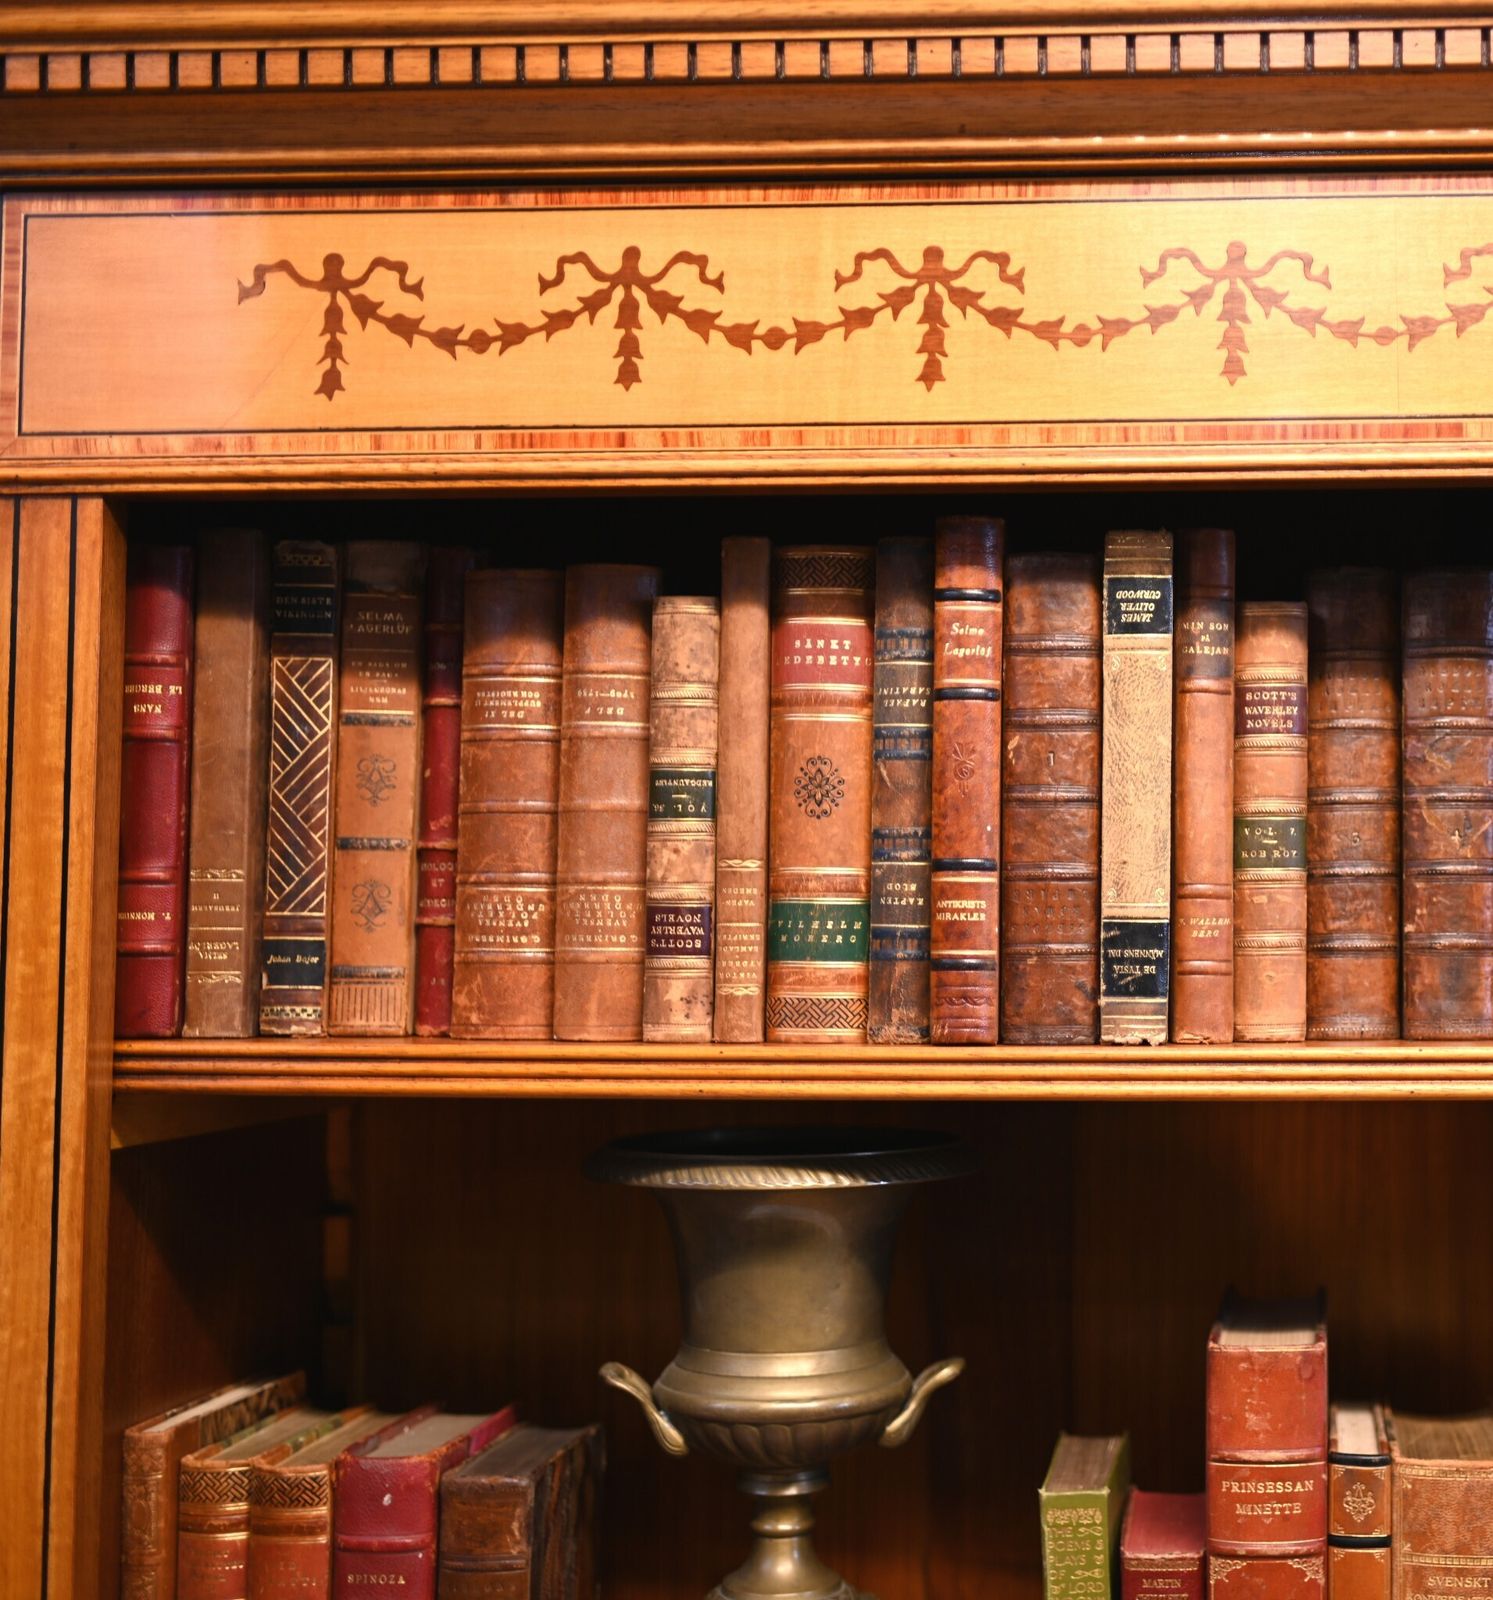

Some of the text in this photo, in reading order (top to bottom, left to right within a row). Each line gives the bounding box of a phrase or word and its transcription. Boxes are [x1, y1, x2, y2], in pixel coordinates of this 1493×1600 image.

[1115, 590, 1161, 599] CURWOOD
[1120, 602, 1155, 611] OLIVER
[357, 610, 404, 622] SELMA
[1121, 613, 1153, 623] JAMES
[950, 622, 985, 636] Selma
[1183, 621, 1229, 630] MIN SON
[1183, 646, 1229, 656] GALEJAN
[168, 684, 183, 694] LE
[878, 687, 931, 696] SABATINI
[1245, 691, 1297, 701] SCOTT'S
[884, 699, 927, 707] RAFAEL
[501, 710, 525, 718] DEL
[596, 707, 625, 715] DEL
[1244, 705, 1299, 715] WAVERLEY
[1246, 719, 1293, 728] NOVELS
[655, 778, 713, 787] REDGAUNTLET
[1244, 827, 1278, 836] VOL.
[1241, 850, 1298, 858] ROB ROY
[886, 883, 918, 891] BLOD
[880, 897, 924, 906] KAPTEN
[936, 900, 987, 909] ANTIKRISTS
[162, 912, 172, 920] T.
[655, 914, 702, 923] NOVELS
[936, 913, 986, 921] MIRAKLER
[478, 920, 530, 928] SVENSKA
[575, 919, 628, 927] SVENSKA
[778, 921, 862, 930] VILHELM
[651, 926, 705, 936] WAVERLEY
[1191, 929, 1219, 938] BERG
[651, 939, 702, 948] SCOTT'S
[780, 934, 857, 944] MOBERG
[198, 951, 229, 960] SELMA
[1107, 949, 1164, 960] MÄNNENS DAL
[266, 955, 320, 965] Johan Bojer
[1113, 965, 1156, 974] DE TYSTA
[1221, 1480, 1314, 1493] PRINSESSAN
[1235, 1502, 1302, 1515] MINETTE
[1047, 1527, 1073, 1538] THE
[1047, 1540, 1091, 1552] POEMS
[1048, 1554, 1086, 1567] PLAYS
[347, 1574, 406, 1585] SPINOZA
[1049, 1569, 1067, 1581] OF
[1142, 1578, 1181, 1588] MARTIN
[1427, 1576, 1492, 1588] SVENSKT
[1069, 1582, 1105, 1594] LORD
